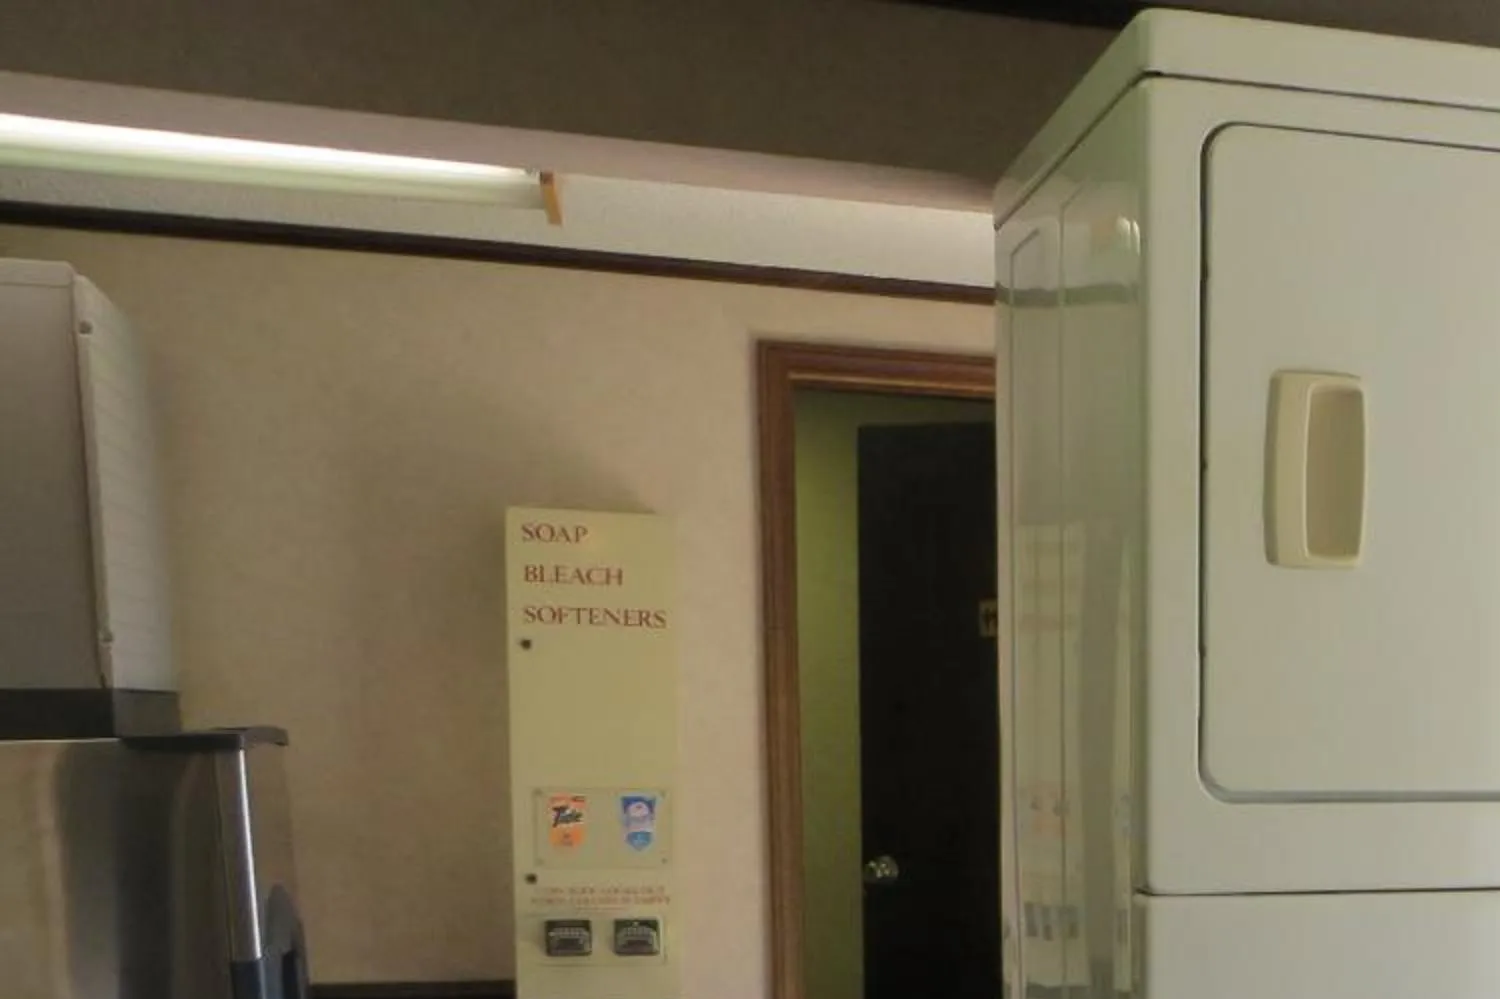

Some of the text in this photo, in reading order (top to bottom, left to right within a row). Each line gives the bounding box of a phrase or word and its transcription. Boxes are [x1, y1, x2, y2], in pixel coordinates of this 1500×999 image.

[521, 523, 588, 543] SOAP
[524, 564, 623, 585] BLEACH
[523, 606, 667, 629] SOFTENERS
